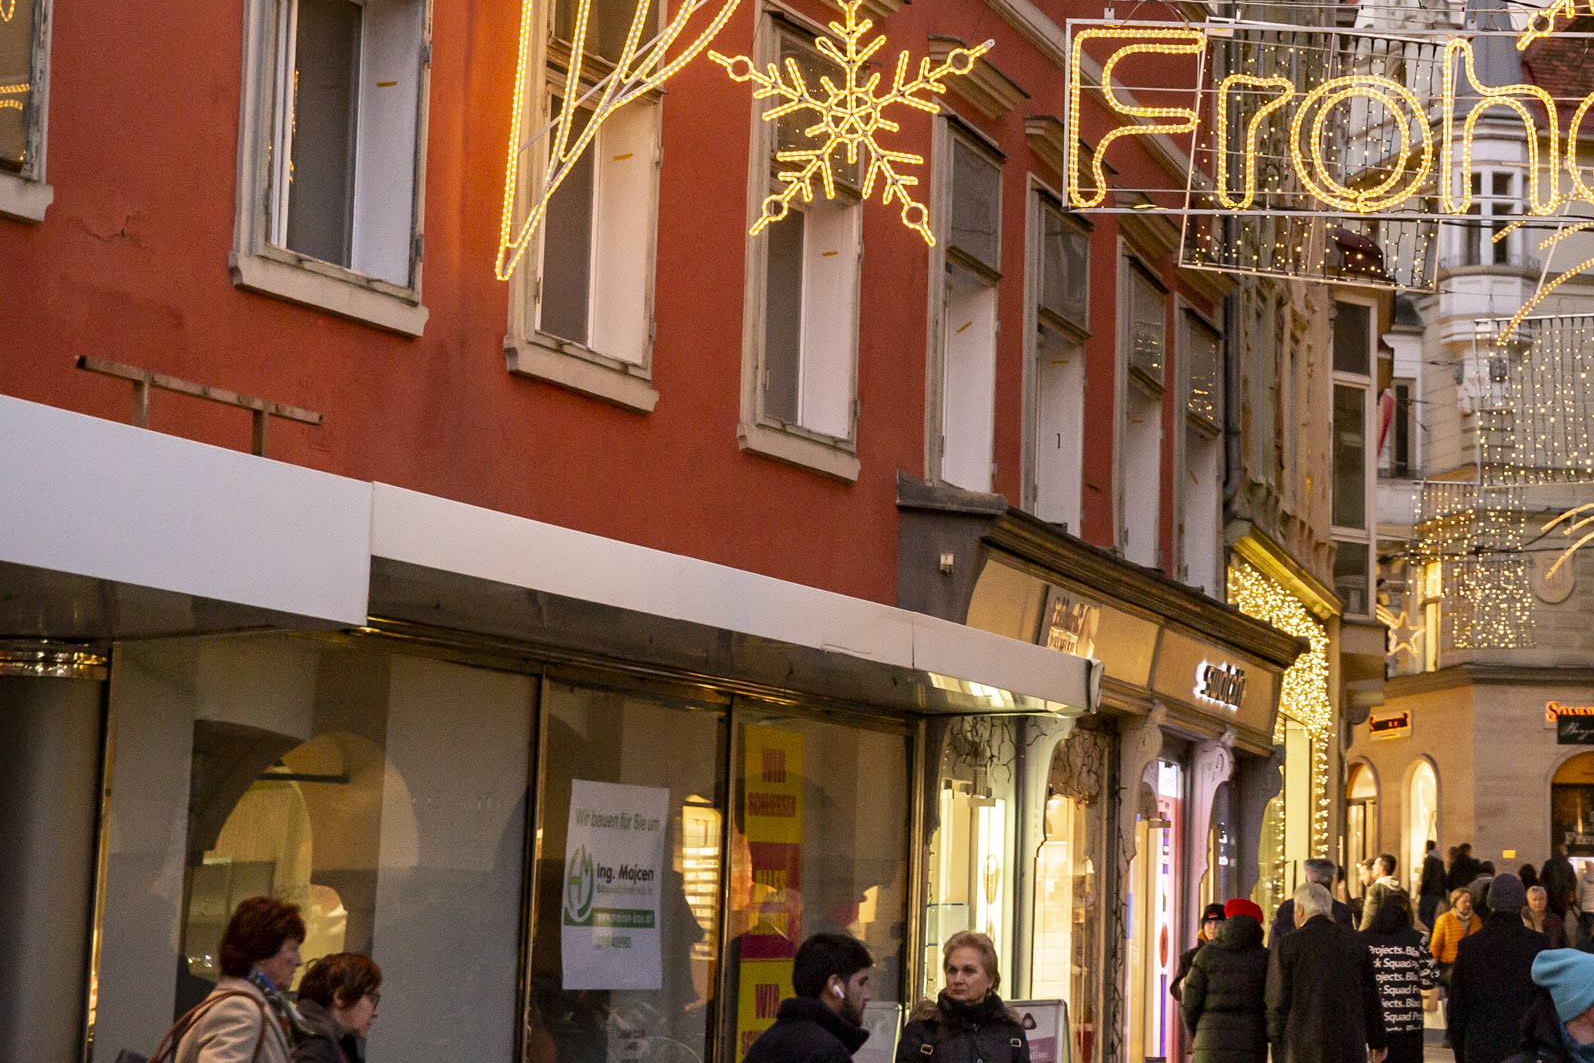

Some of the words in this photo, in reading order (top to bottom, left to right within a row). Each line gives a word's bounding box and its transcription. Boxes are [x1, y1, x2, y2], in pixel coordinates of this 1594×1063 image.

[591, 809, 619, 829] bauen
[620, 812, 632, 830] für
[634, 813, 646, 831] Sie
[596, 863, 615, 883] Ing.
[618, 864, 654, 885] Majcen
[1383, 958, 1411, 970] Squad
[1383, 985, 1411, 997] Squad
[1384, 1012, 1411, 1024] Squad
